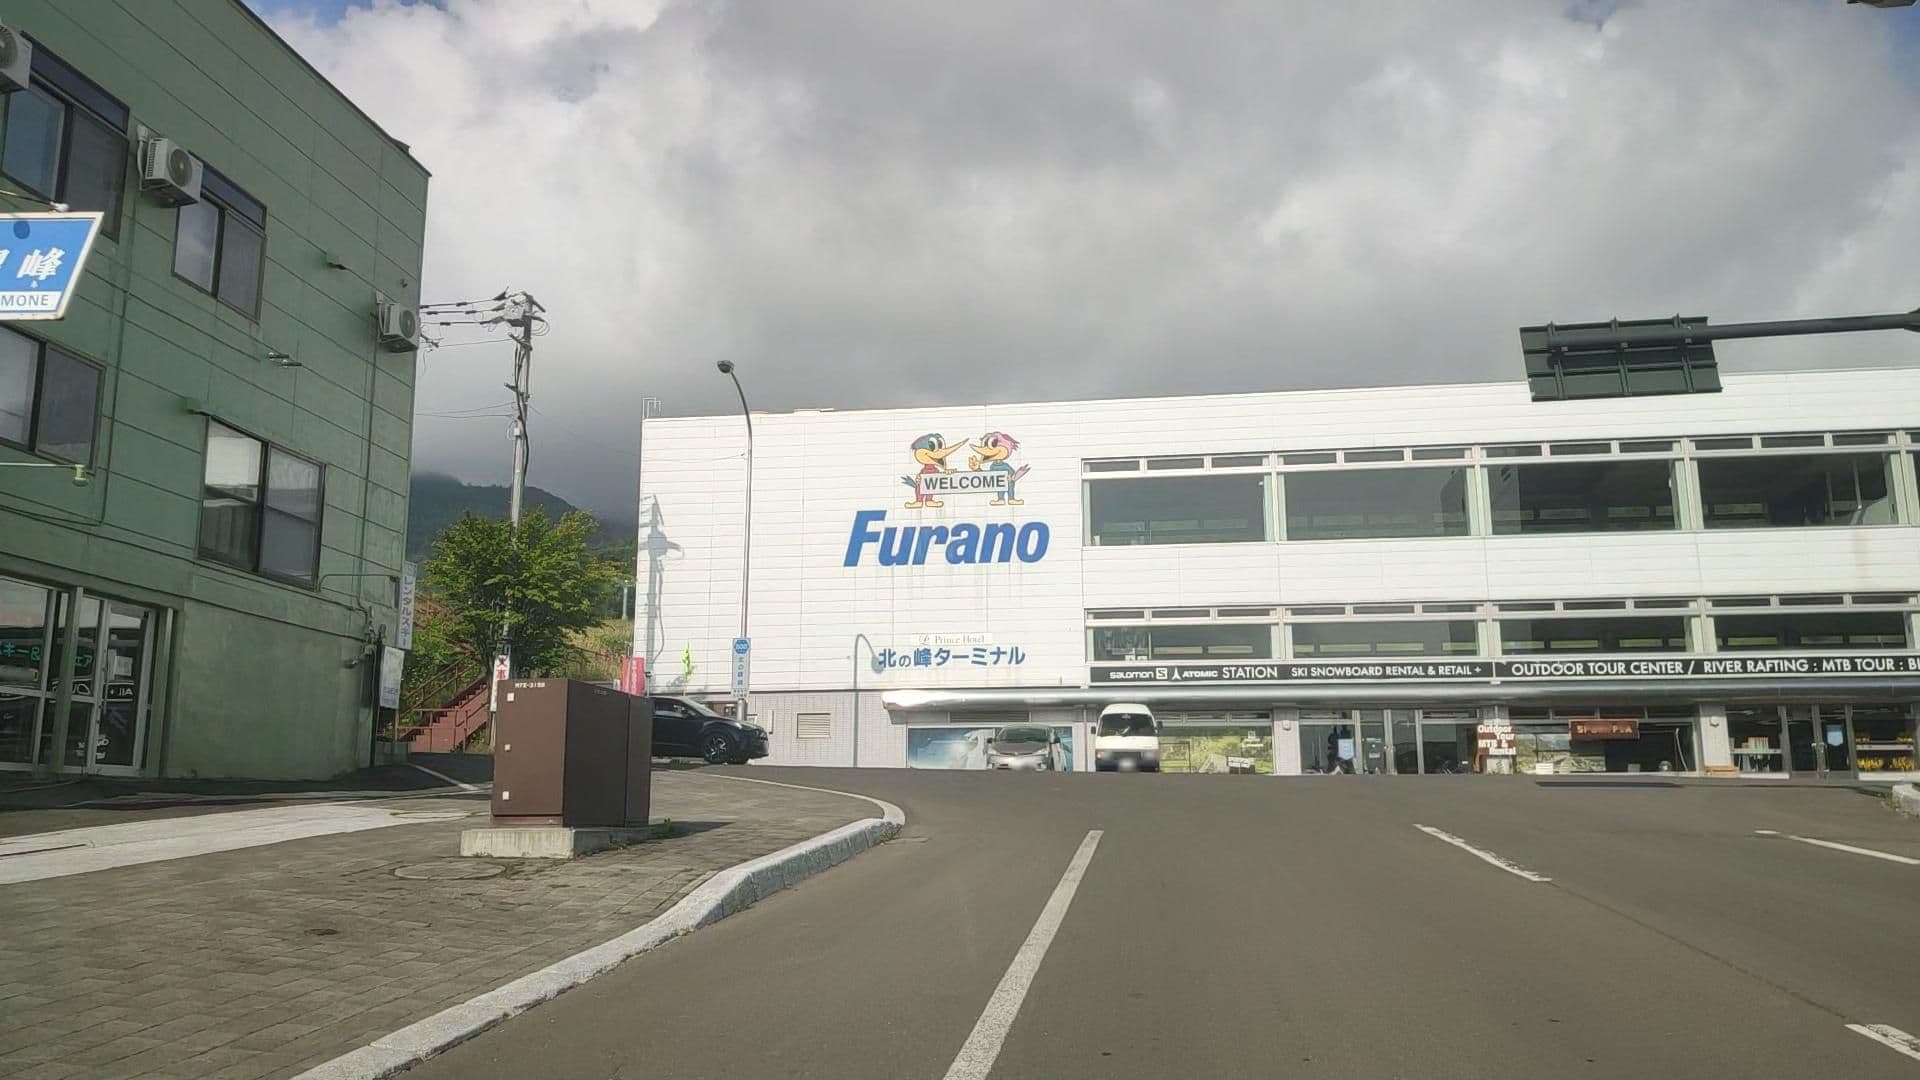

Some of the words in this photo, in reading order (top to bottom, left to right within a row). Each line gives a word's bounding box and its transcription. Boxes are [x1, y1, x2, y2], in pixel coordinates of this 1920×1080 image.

[0, 247, 65, 280] 峰
[924, 474, 1006, 490] WELCOME
[843, 509, 1050, 567] Furano
[935, 635, 960, 644] Prince
[963, 634, 985, 643] Hotel
[878, 646, 1026, 668] 北の峰ターミナル
[1182, 670, 1219, 678] ATOMIC
[1222, 667, 1278, 678] STATION
[1291, 667, 1308, 677] SKI
[1311, 666, 1383, 677] SNOWBOARD
[1386, 666, 1425, 676] RENTAL
[1427, 666, 1436, 675] &
[1439, 665, 1472, 675] RETAIL
[1511, 663, 1585, 676] OUTDOOR
[1588, 662, 1626, 675] TOUR
[1630, 661, 1685, 675] CENTER
[1704, 660, 1743, 673] RIVER
[1747, 659, 1808, 673] RAFTING
[1822, 659, 1850, 672] MTB
[1855, 658, 1895, 671] TOUR
